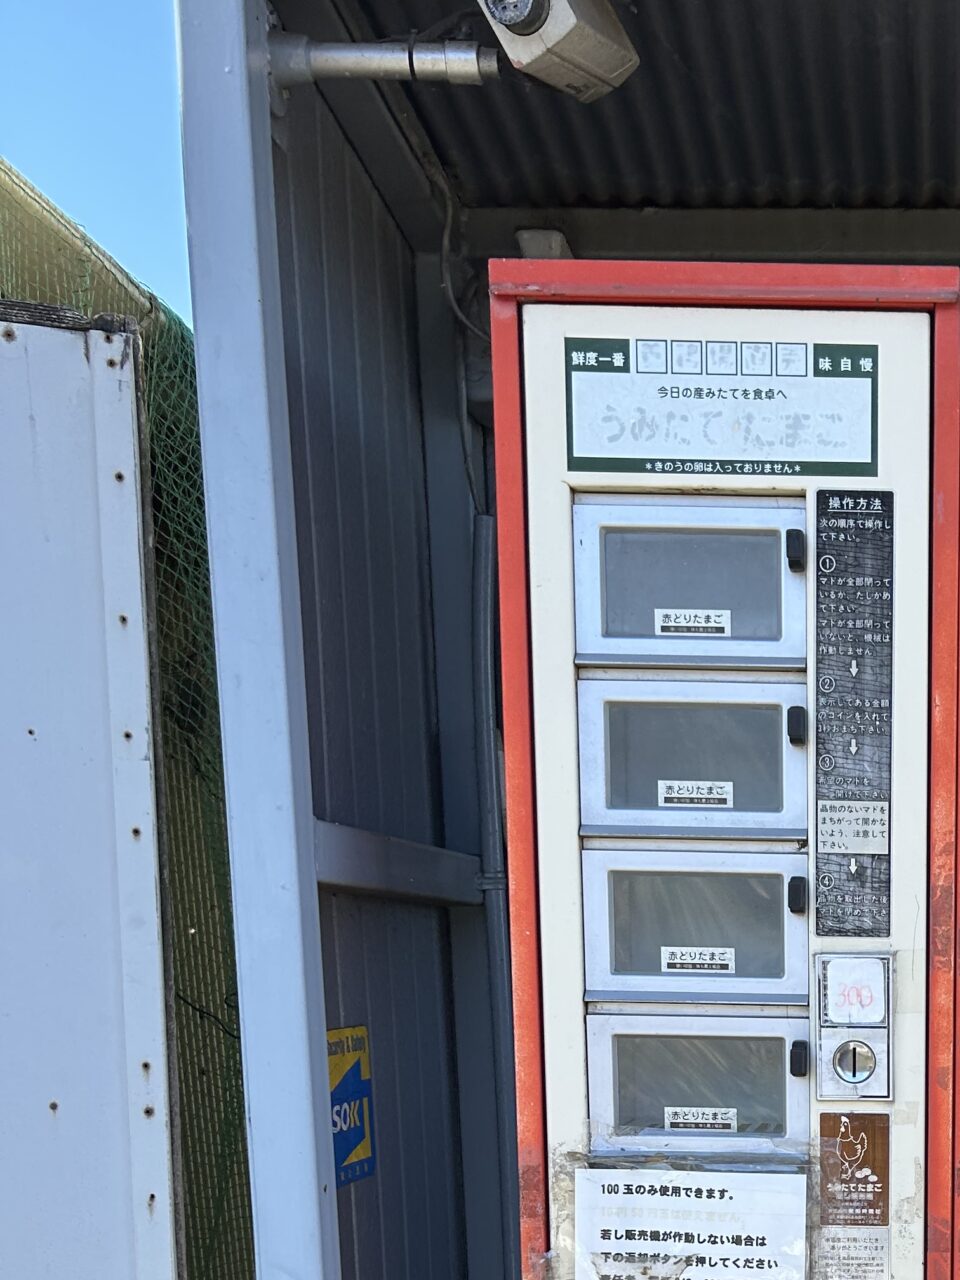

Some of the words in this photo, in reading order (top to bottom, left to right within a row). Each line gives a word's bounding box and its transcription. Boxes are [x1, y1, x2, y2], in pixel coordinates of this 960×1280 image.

[571, 351, 625, 367] 鮮度一番
[818, 357, 873, 373] 味自慢
[657, 386, 788, 401] 今日の産みたてを食卓へ
[828, 497, 883, 511] 操作方法
[819, 518, 891, 530] 次の順序で操作し
[662, 613, 723, 624] 赤どりたまご
[665, 785, 725, 796] 赤どりたまご
[819, 803, 887, 814] 品物のないマドを
[820, 815, 888, 826] まちがって開かな
[820, 828, 887, 839] いよう、注意して
[820, 840, 849, 850] 下さい。
[668, 951, 727, 962] 赤どりたまご
[332, 1100, 360, 1134] SOK
[671, 1111, 730, 1122] 赤どりたまご
[600, 1228, 767, 1247] 若し販売機が作動しない場合は
[600, 1252, 778, 1270] 下の返却ボタンを押してください
